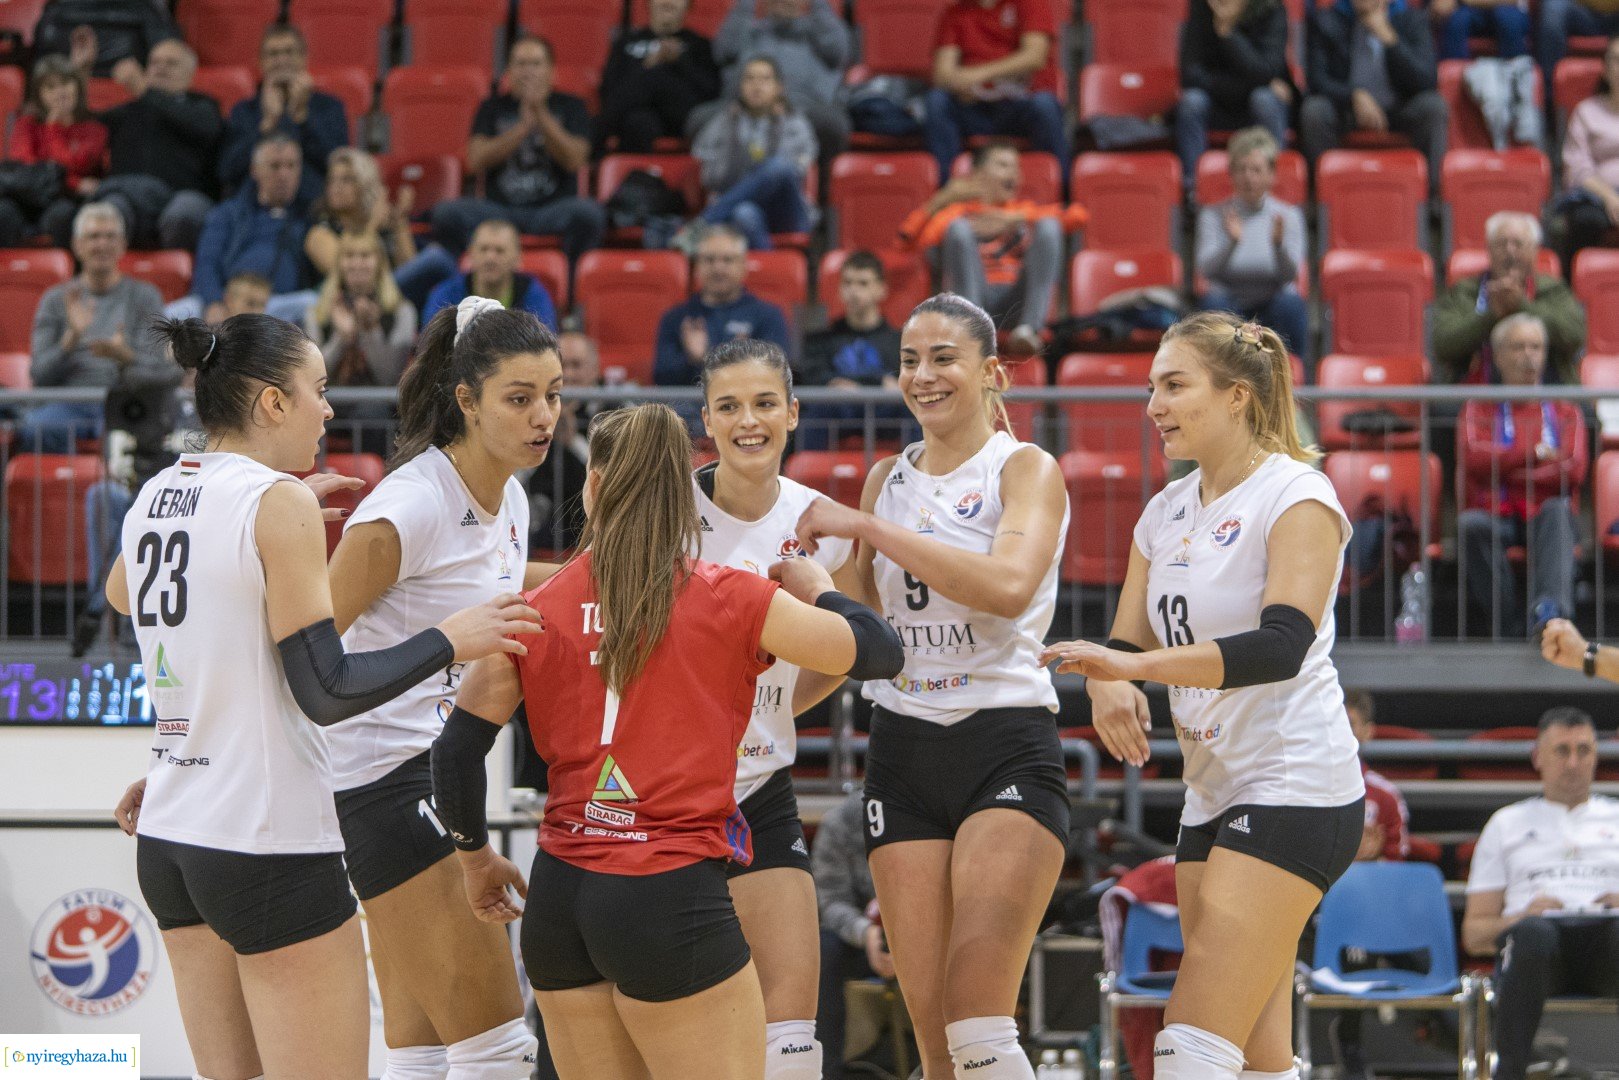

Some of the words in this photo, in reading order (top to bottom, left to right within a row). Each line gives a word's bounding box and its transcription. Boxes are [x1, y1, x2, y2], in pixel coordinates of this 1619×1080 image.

[147, 485, 202, 519] LEBAN
[460, 519, 479, 527] adidas
[136, 530, 190, 628] 23
[903, 568, 929, 612] 9
[1157, 594, 1195, 648] 13
[995, 793, 1023, 801] adidas
[586, 806, 633, 826] STRABAG
[866, 798, 885, 838] 9
[1228, 821, 1251, 835] adidas
[62, 891, 125, 910] FATUM
